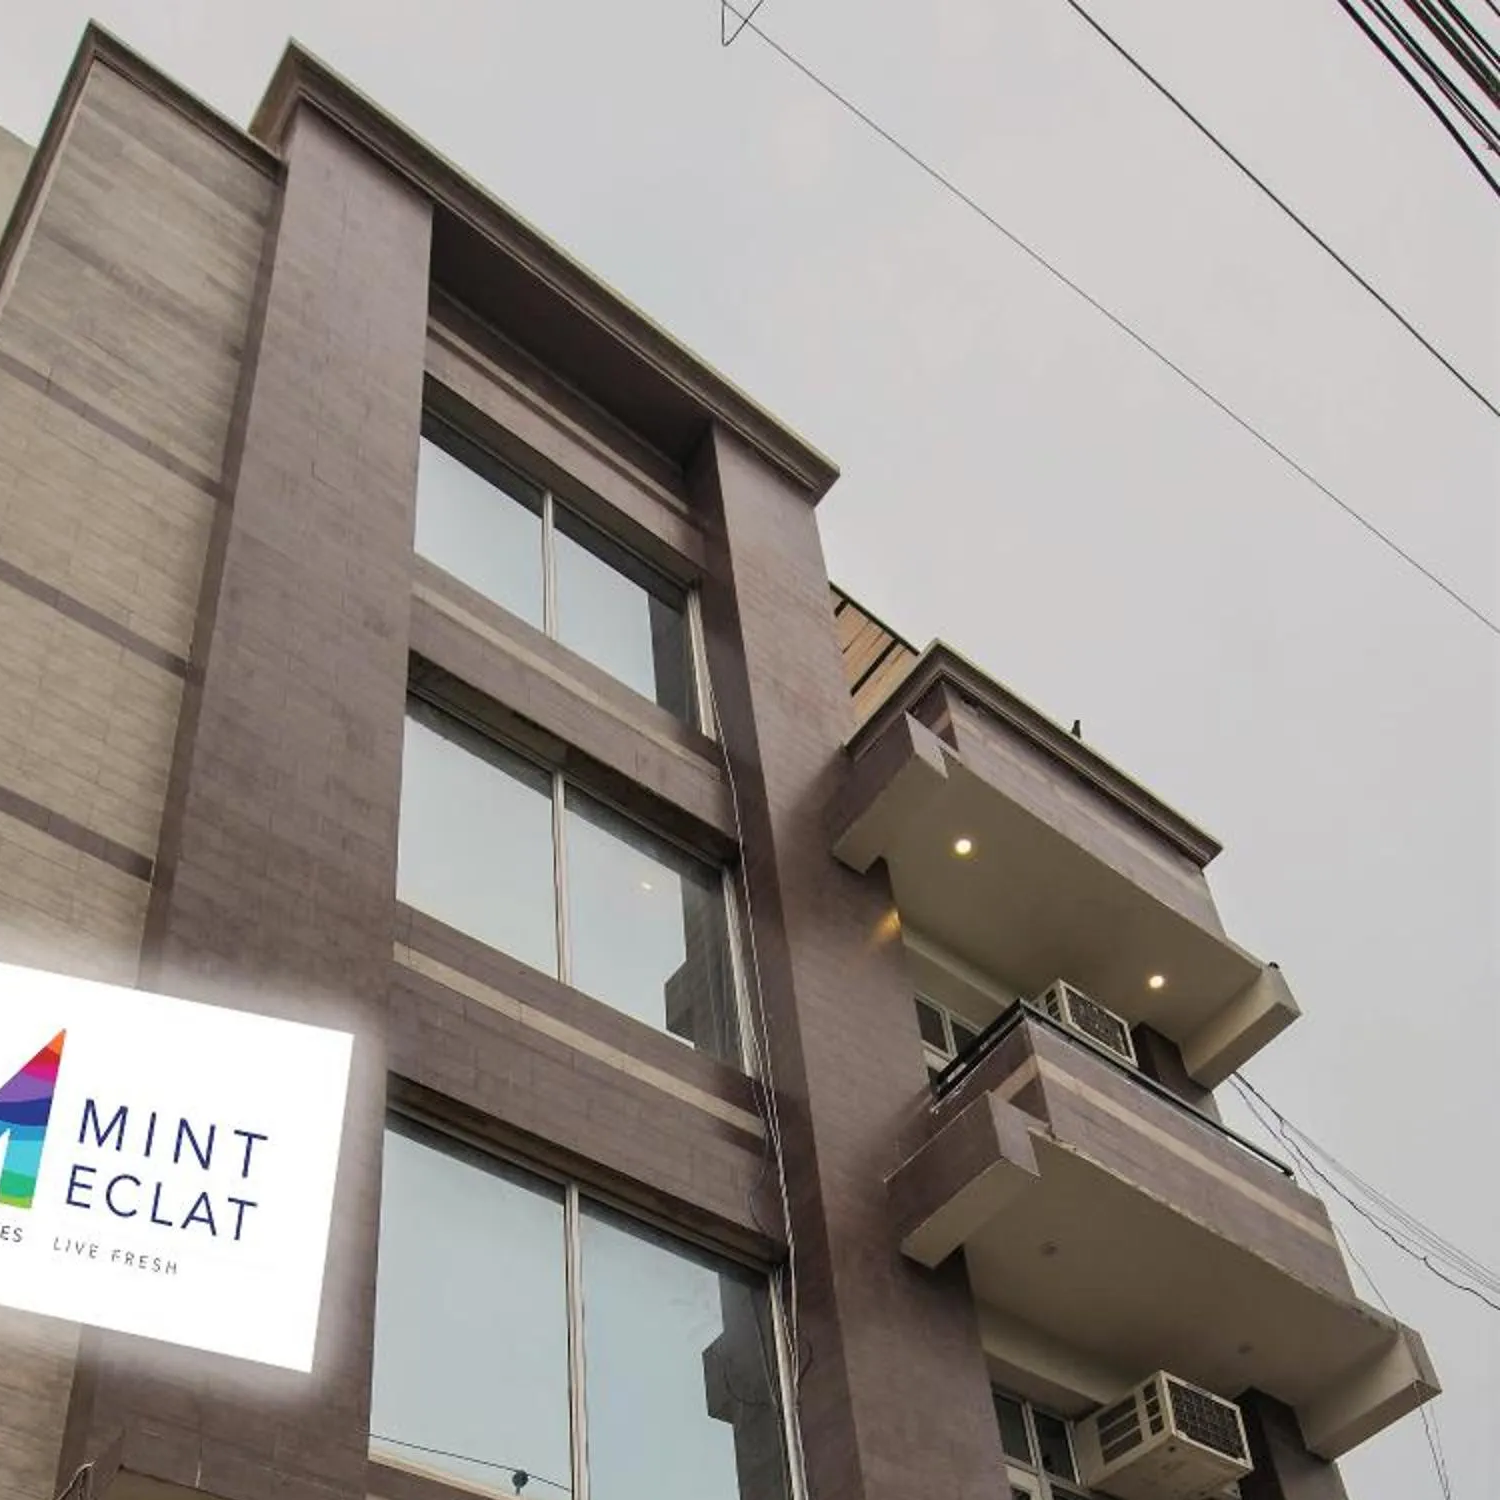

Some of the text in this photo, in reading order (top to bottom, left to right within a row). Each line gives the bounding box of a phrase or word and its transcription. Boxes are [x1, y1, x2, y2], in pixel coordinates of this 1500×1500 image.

[77, 1098, 269, 1179] MINT
[65, 1163, 258, 1242] ECLAT
[53, 1236, 178, 1275] LIVE FRESH
